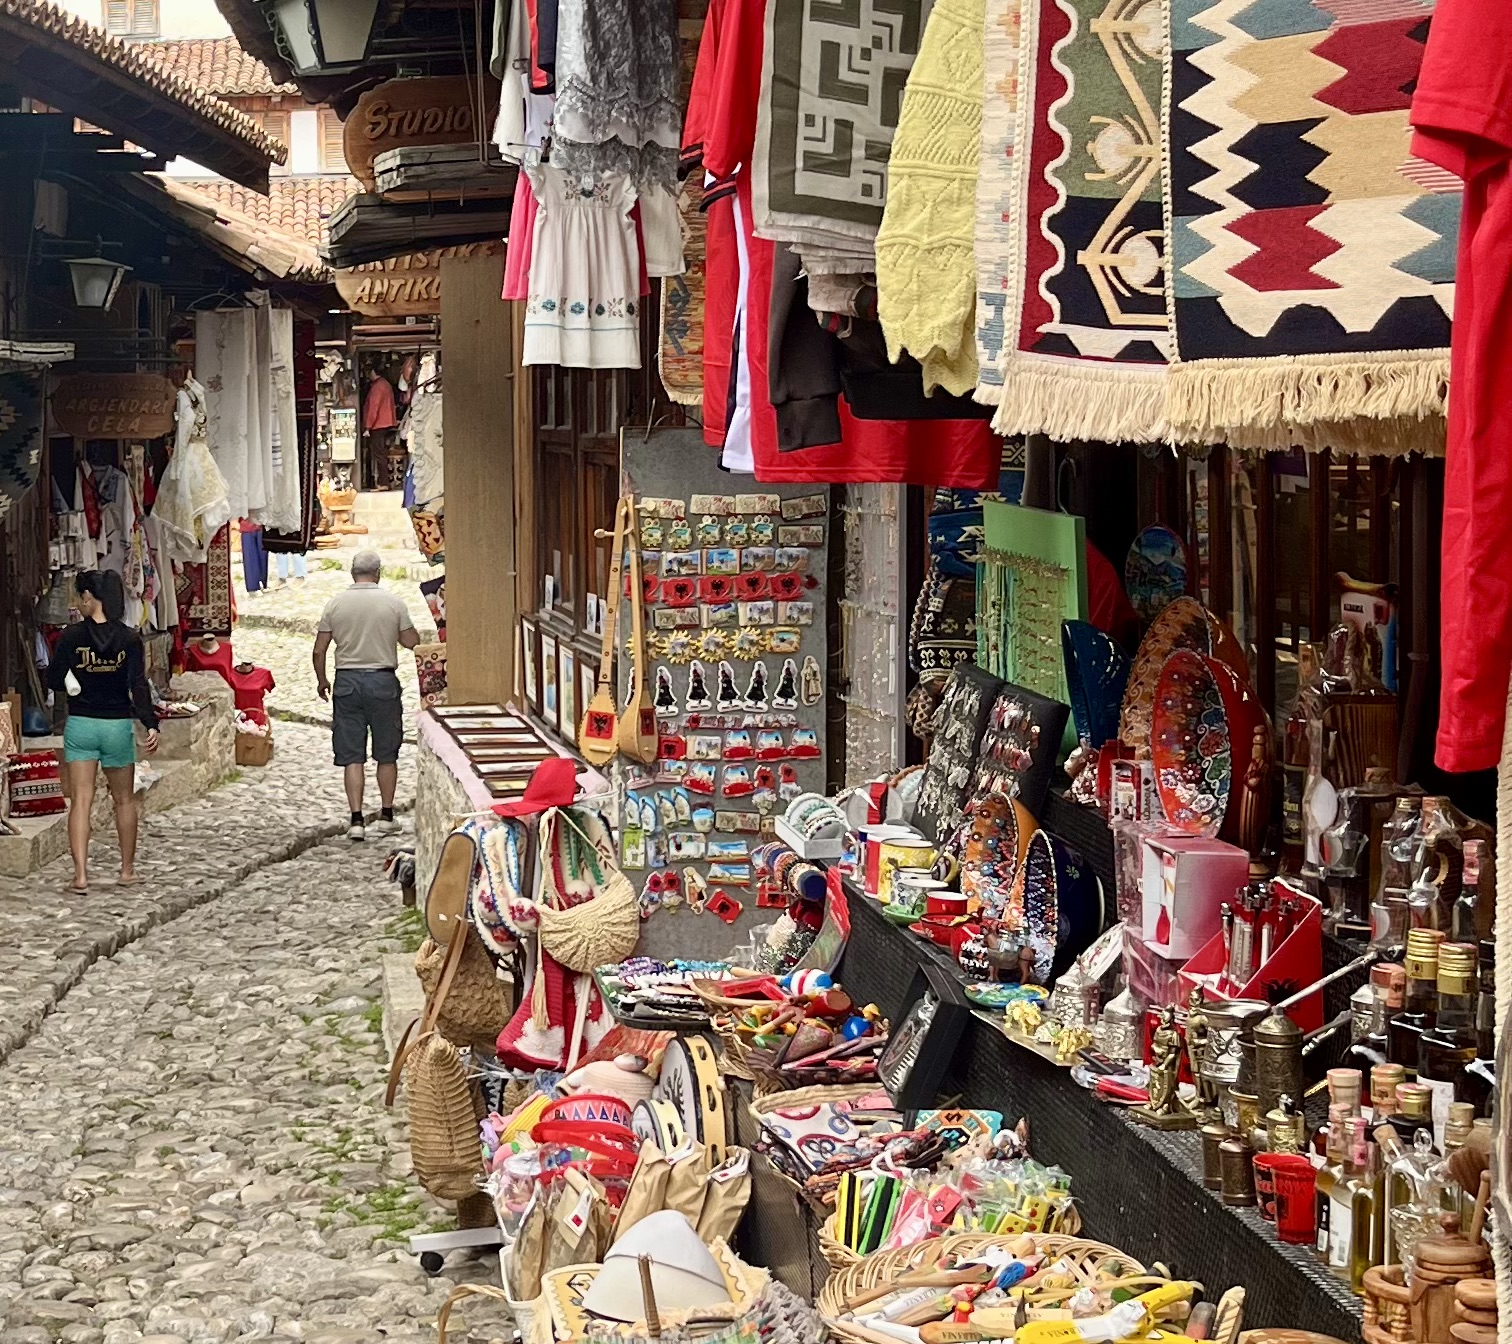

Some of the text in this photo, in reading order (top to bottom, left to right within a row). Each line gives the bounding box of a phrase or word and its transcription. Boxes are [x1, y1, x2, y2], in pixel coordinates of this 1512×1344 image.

[363, 100, 472, 140] STUDIO
[65, 397, 169, 414] ARGJENDARI
[88, 415, 141, 433] CELA
